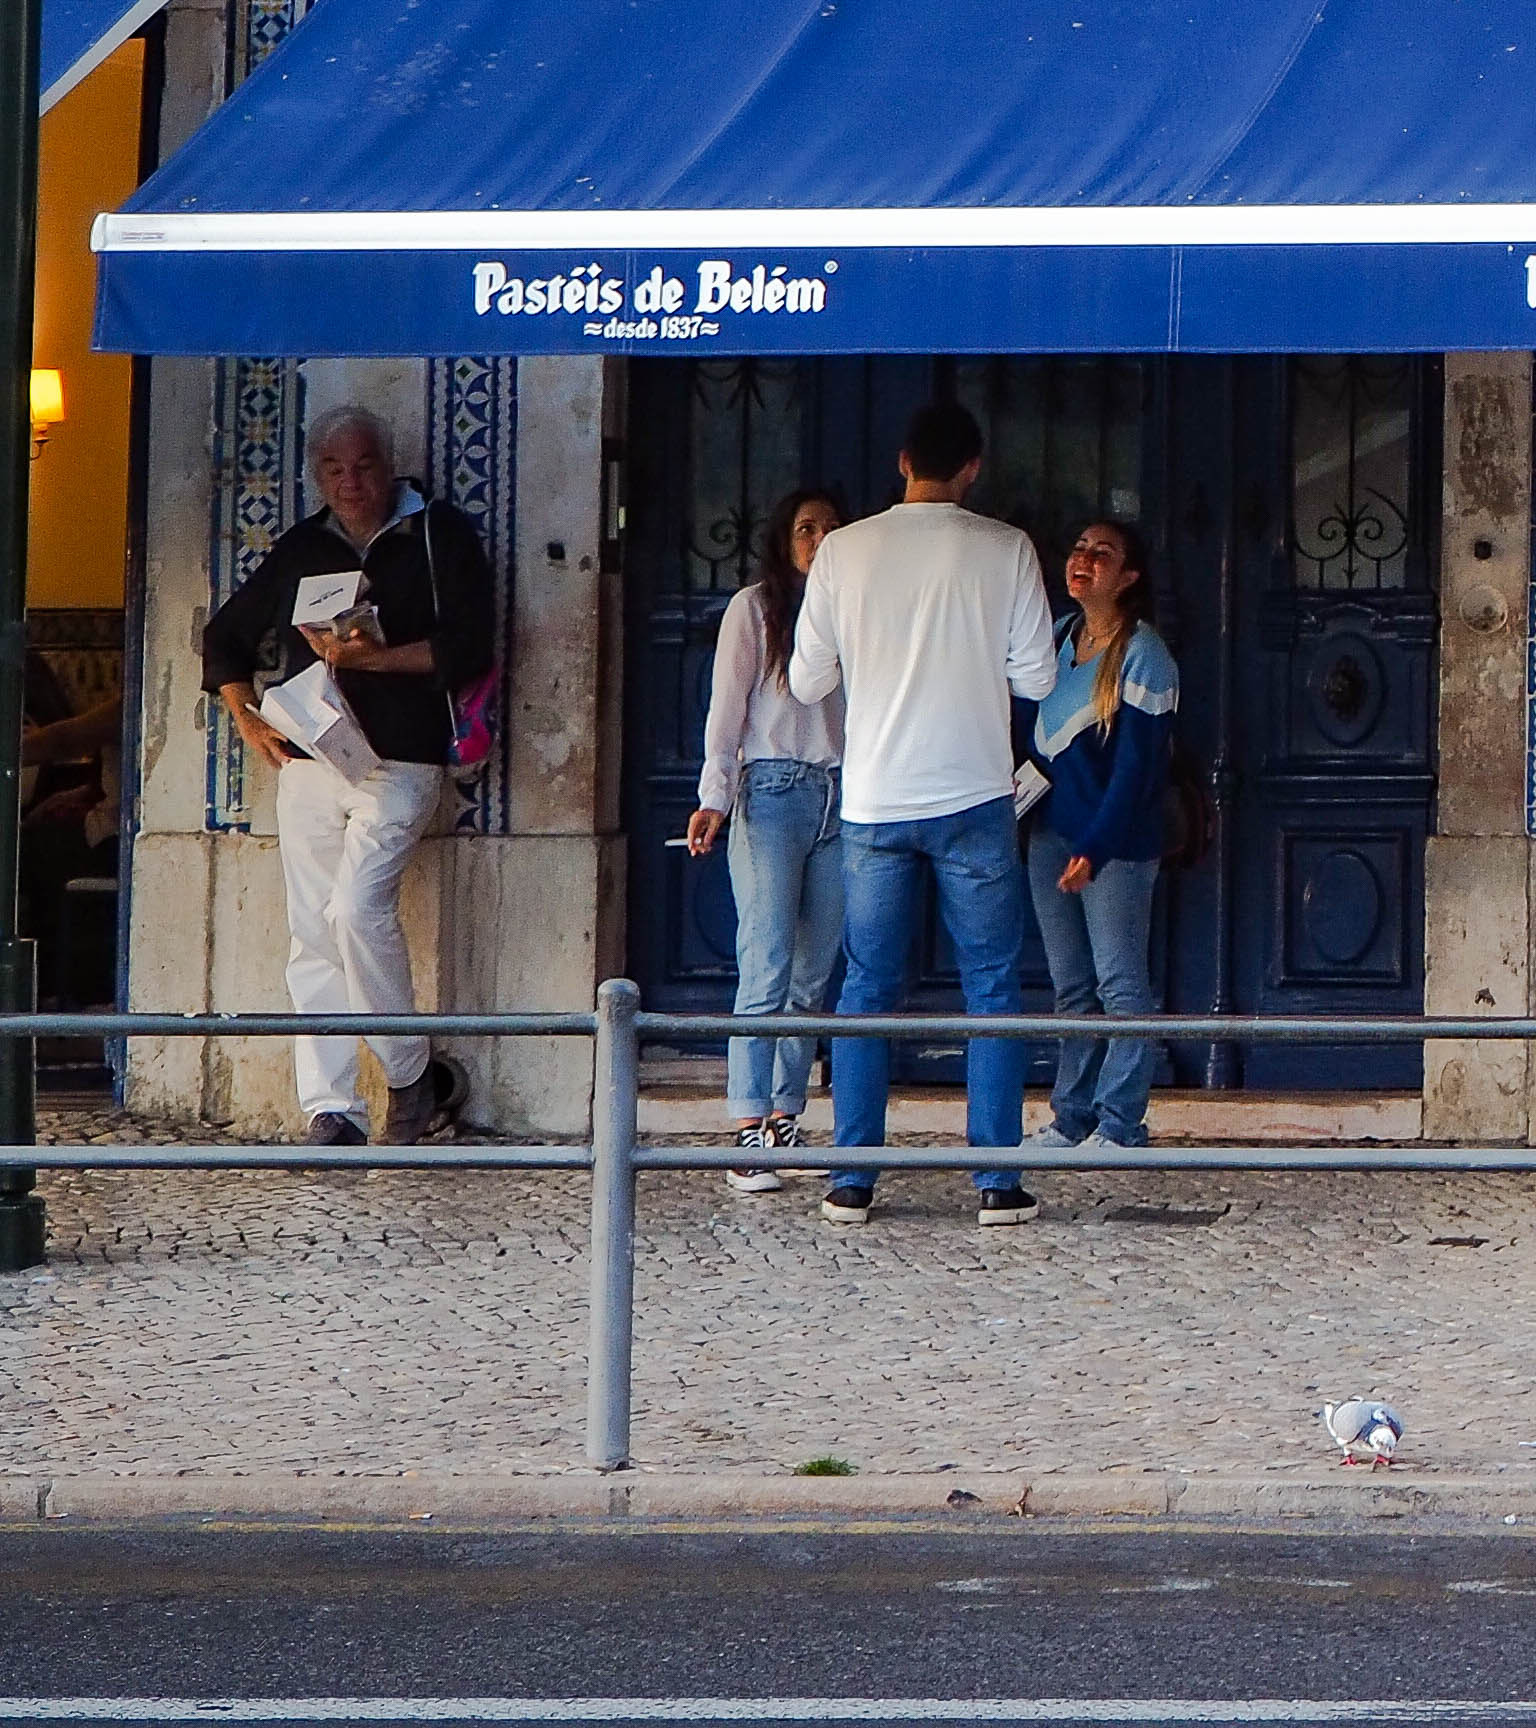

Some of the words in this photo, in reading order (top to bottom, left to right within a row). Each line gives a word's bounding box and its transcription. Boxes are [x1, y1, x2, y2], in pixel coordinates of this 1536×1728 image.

[472, 261, 624, 316] Pastéis
[633, 266, 685, 314] de
[603, 316, 658, 339] desde
[660, 315, 703, 340] 1837
